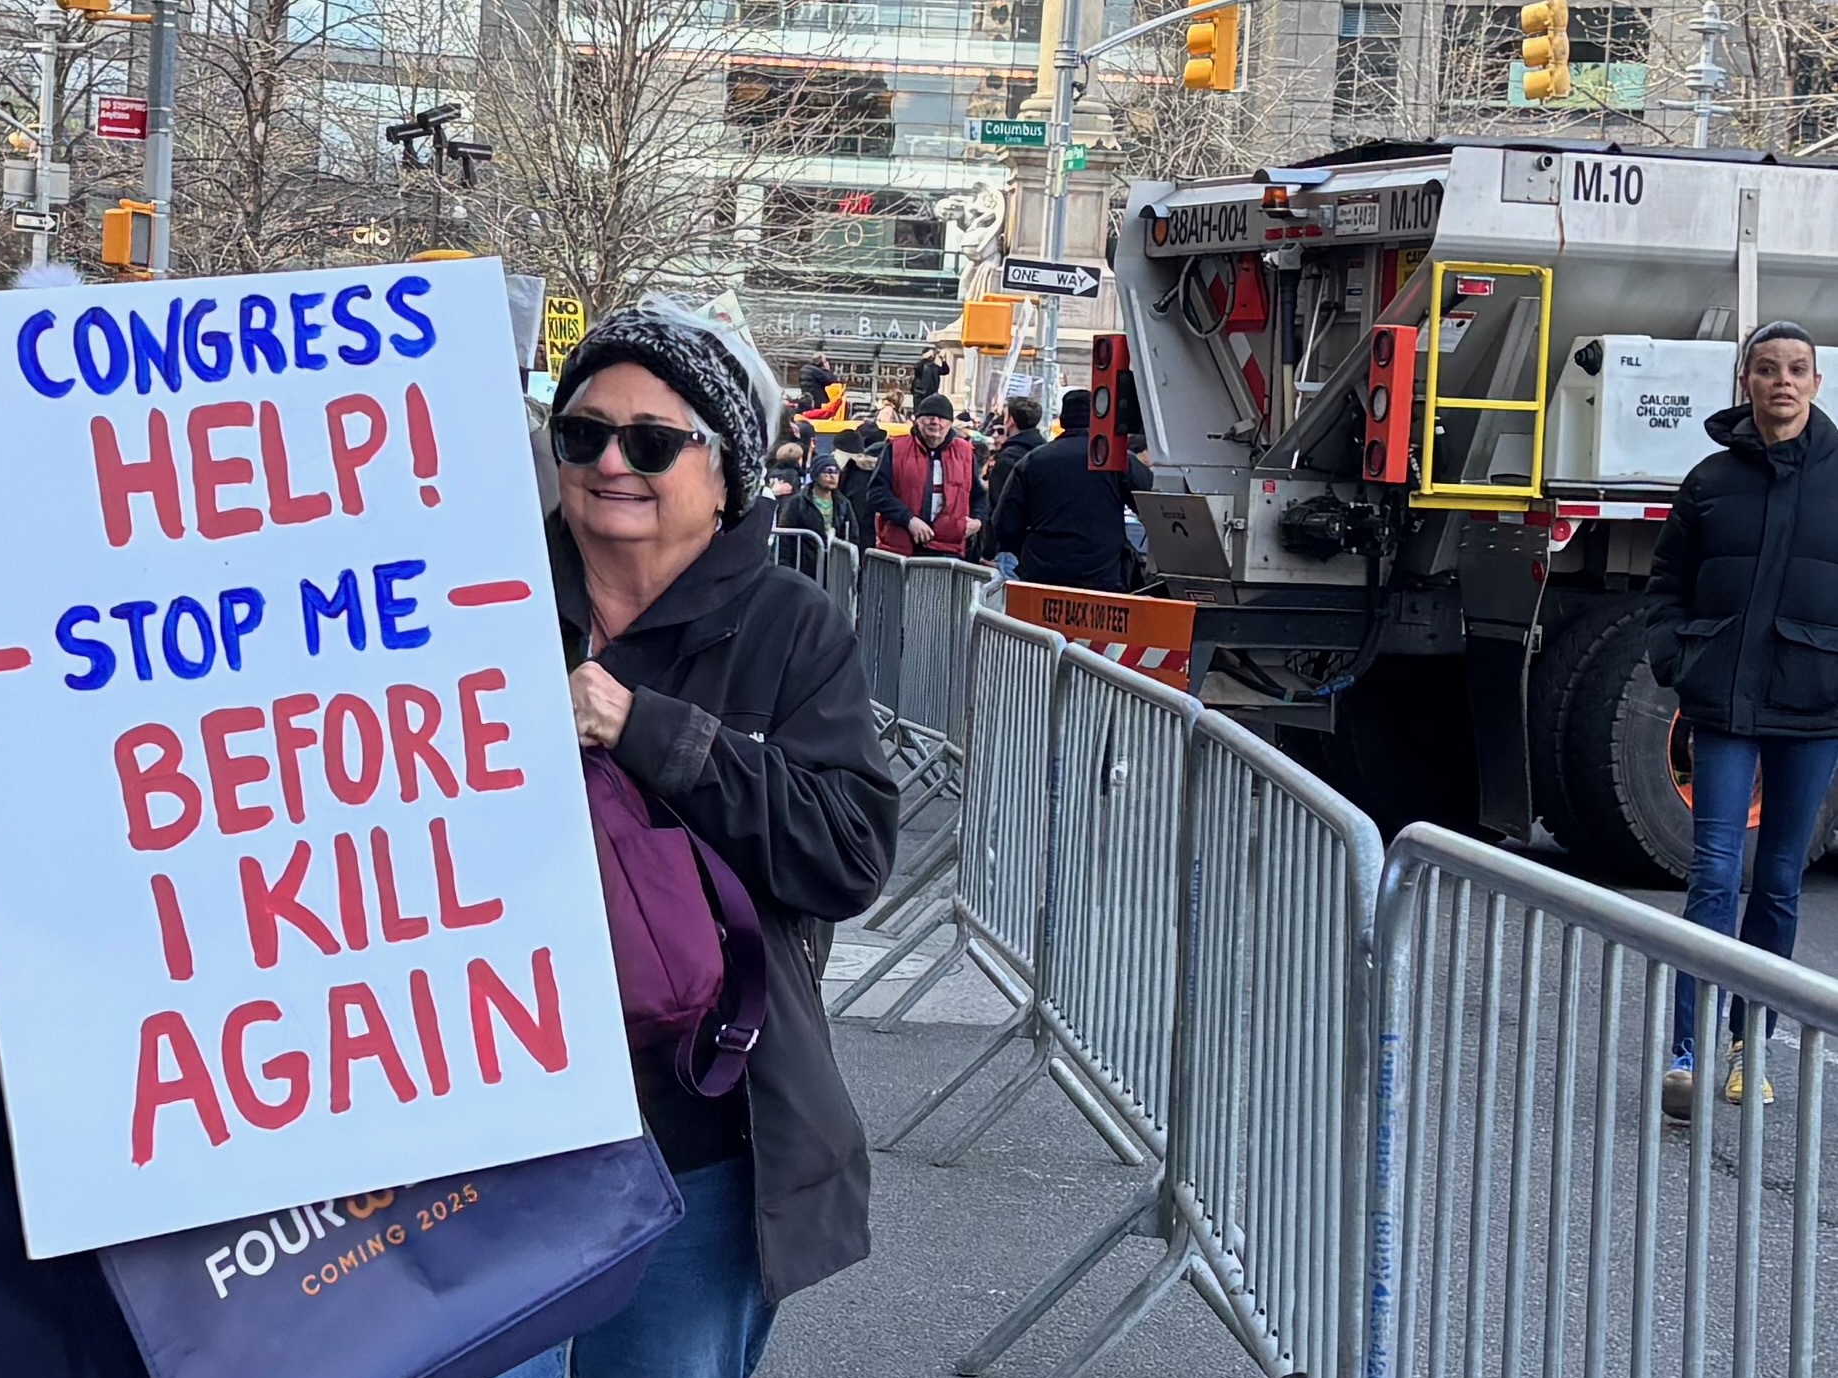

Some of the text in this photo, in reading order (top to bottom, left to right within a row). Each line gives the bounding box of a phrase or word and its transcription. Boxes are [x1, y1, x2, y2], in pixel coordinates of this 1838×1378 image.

[984, 121, 1044, 137] Columbus
[1573, 160, 1644, 206] M.10
[1169, 203, 1248, 245] 38AH-004
[1390, 190, 1433, 231] M.10
[1011, 268, 1089, 288] ONE WAY
[548, 300, 579, 316] NO
[857, 315, 937, 339] BAN
[16, 275, 437, 399] CONGRESS
[548, 316, 580, 341] KINGS
[1620, 355, 1643, 367] FILL
[1636, 405, 1693, 418] CHLORIDE
[1639, 394, 1690, 406] CALCIUM
[1648, 416, 1681, 429] ONLY
[89, 382, 441, 548] HELP!
[55, 558, 434, 691] STOP ME
[1042, 597, 1130, 634] KEEP BACK 100 FEET
[113, 667, 525, 852] BEFORE
[150, 816, 505, 981] I KILL
[130, 945, 568, 1170] AGAIN
[300, 1223, 406, 1297] COMING
[416, 1183, 480, 1233] 2025
